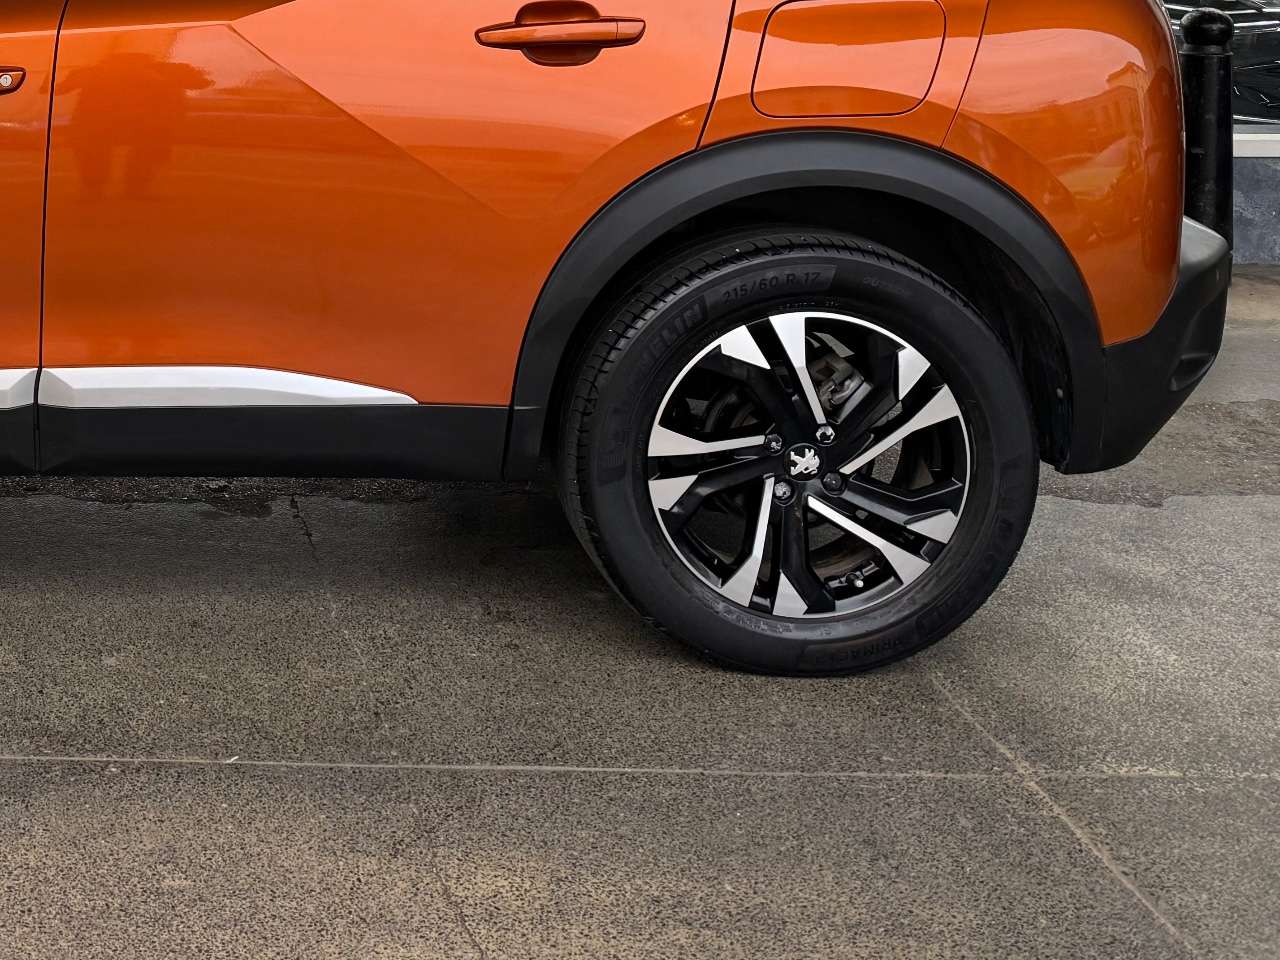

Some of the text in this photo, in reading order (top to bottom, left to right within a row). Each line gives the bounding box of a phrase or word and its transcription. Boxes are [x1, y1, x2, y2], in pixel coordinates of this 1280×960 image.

[722, 276, 780, 304] 215/60
[784, 273, 798, 286] R
[802, 271, 821, 285] 17
